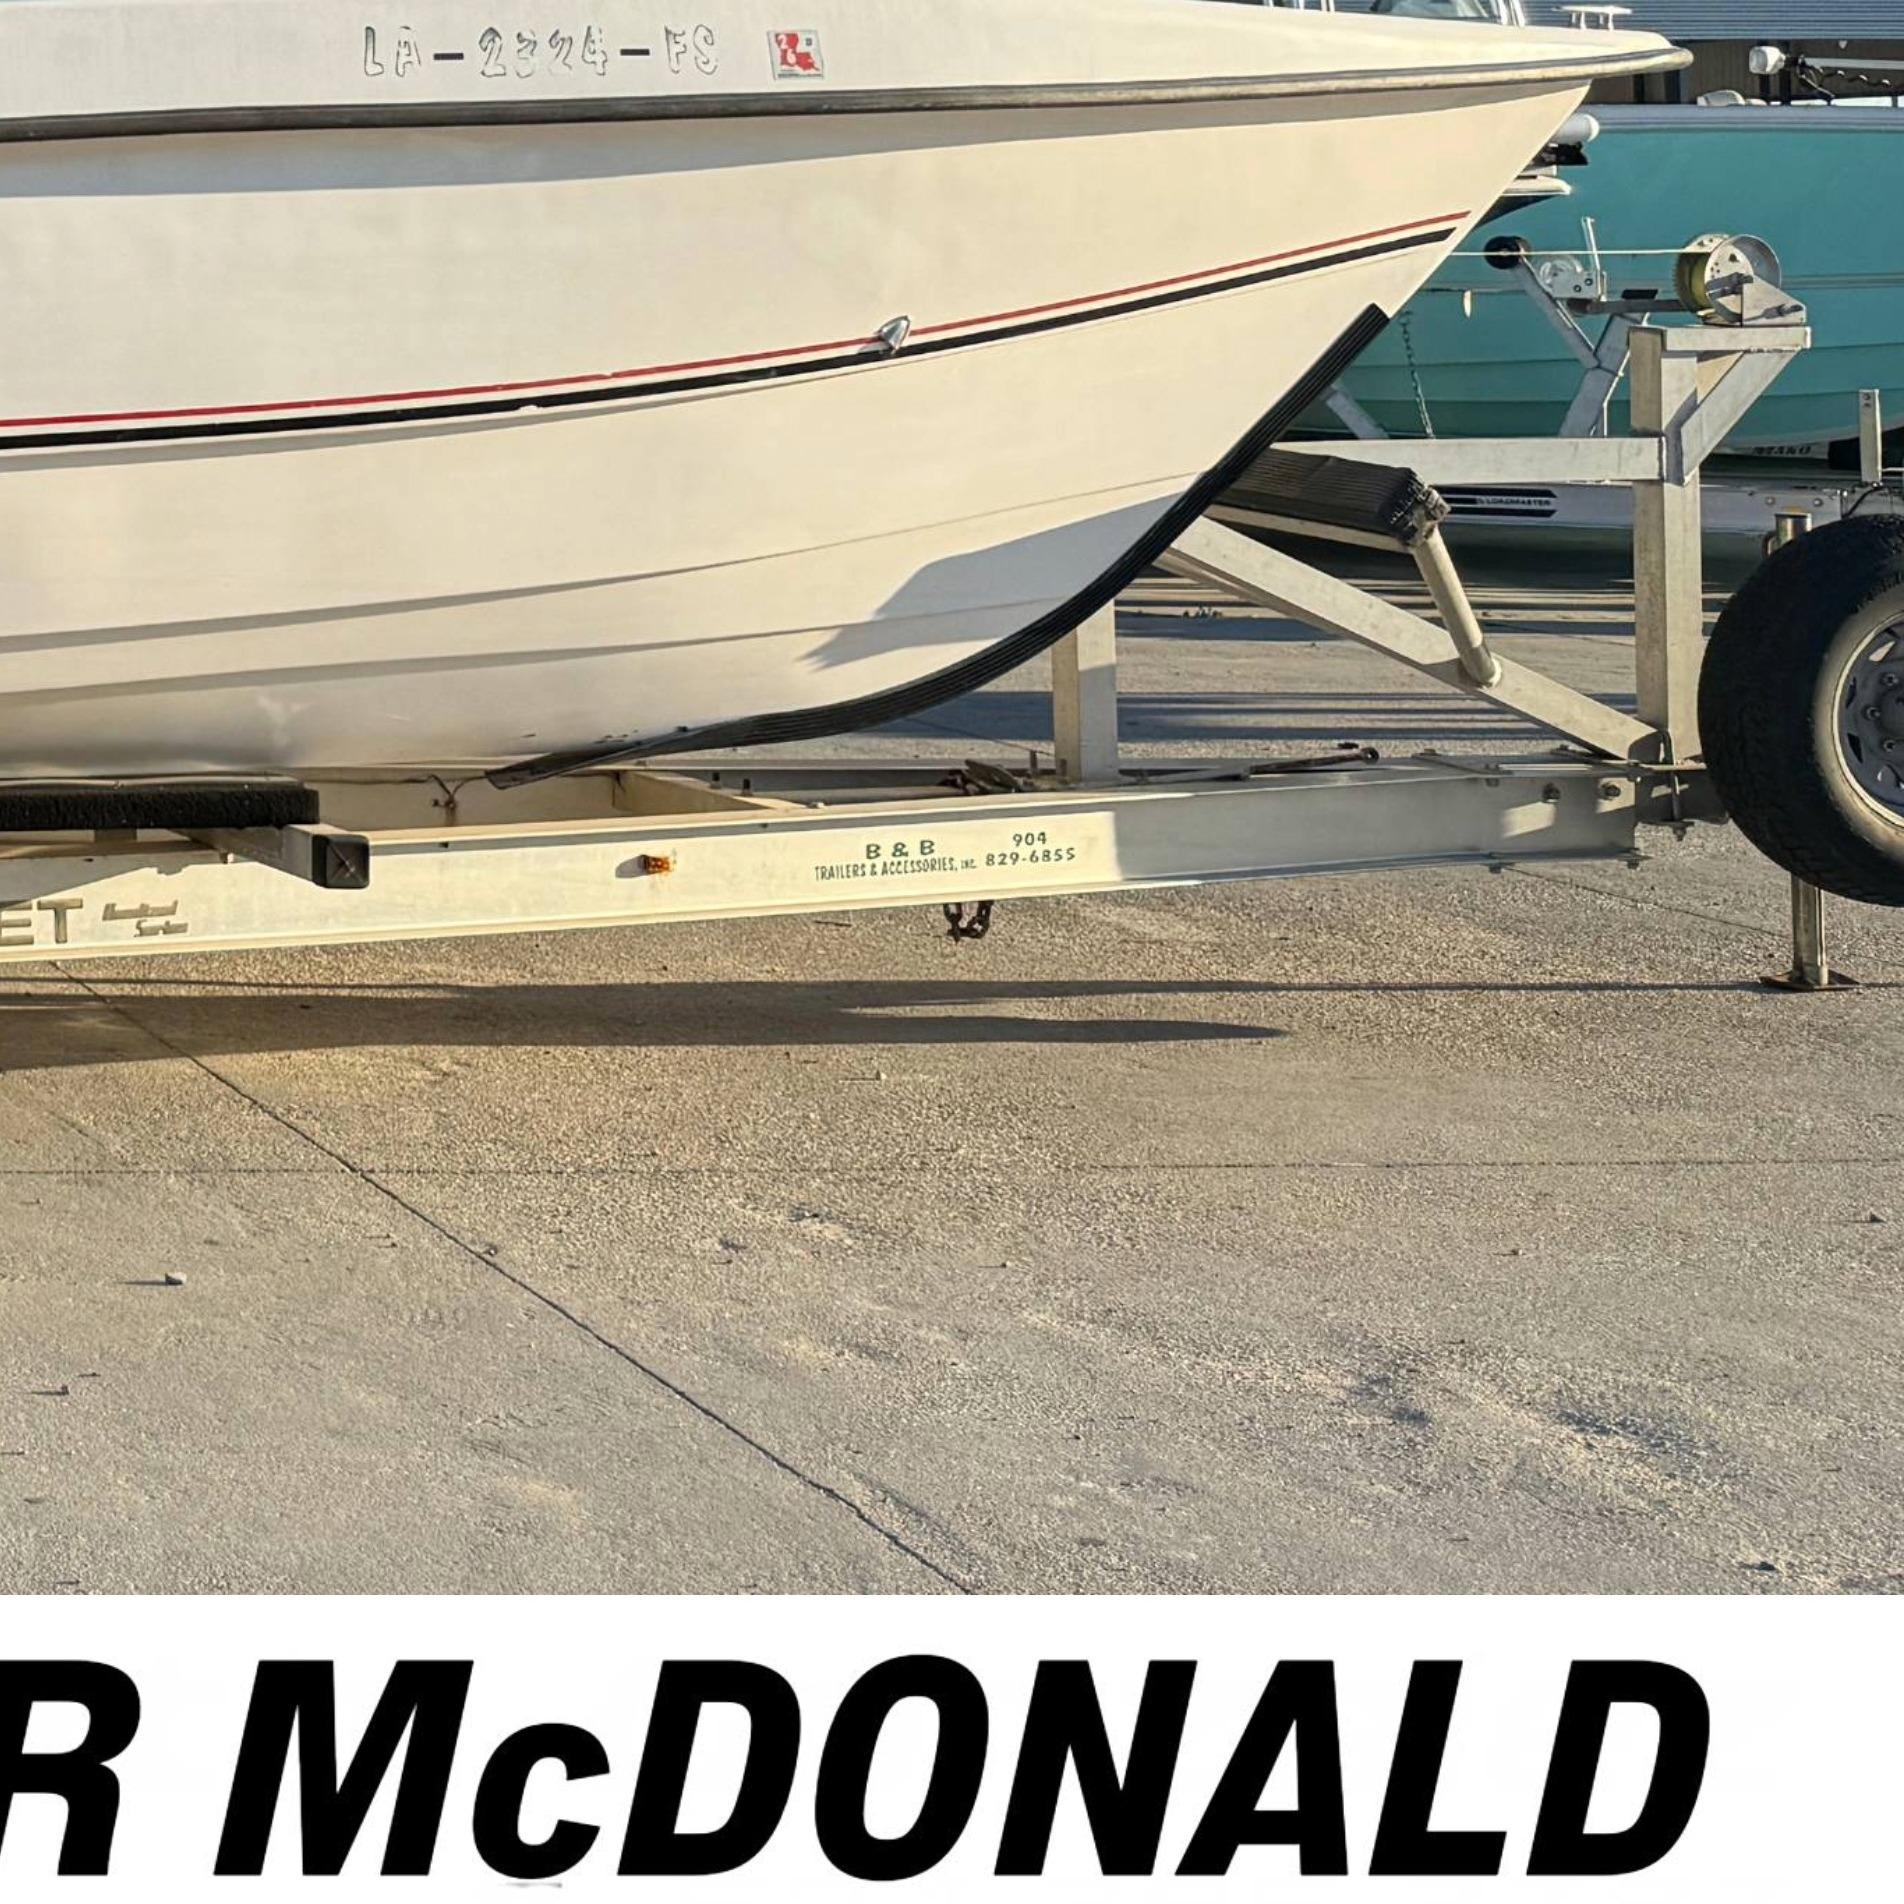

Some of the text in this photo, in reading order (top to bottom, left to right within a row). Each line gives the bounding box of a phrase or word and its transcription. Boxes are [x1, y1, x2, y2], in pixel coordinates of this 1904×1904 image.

[1013, 831, 1047, 847] 904
[866, 839, 935, 860] B & B
[985, 847, 1077, 867] 829-6855
[815, 862, 866, 881] TRAILERS
[870, 862, 877, 877] &
